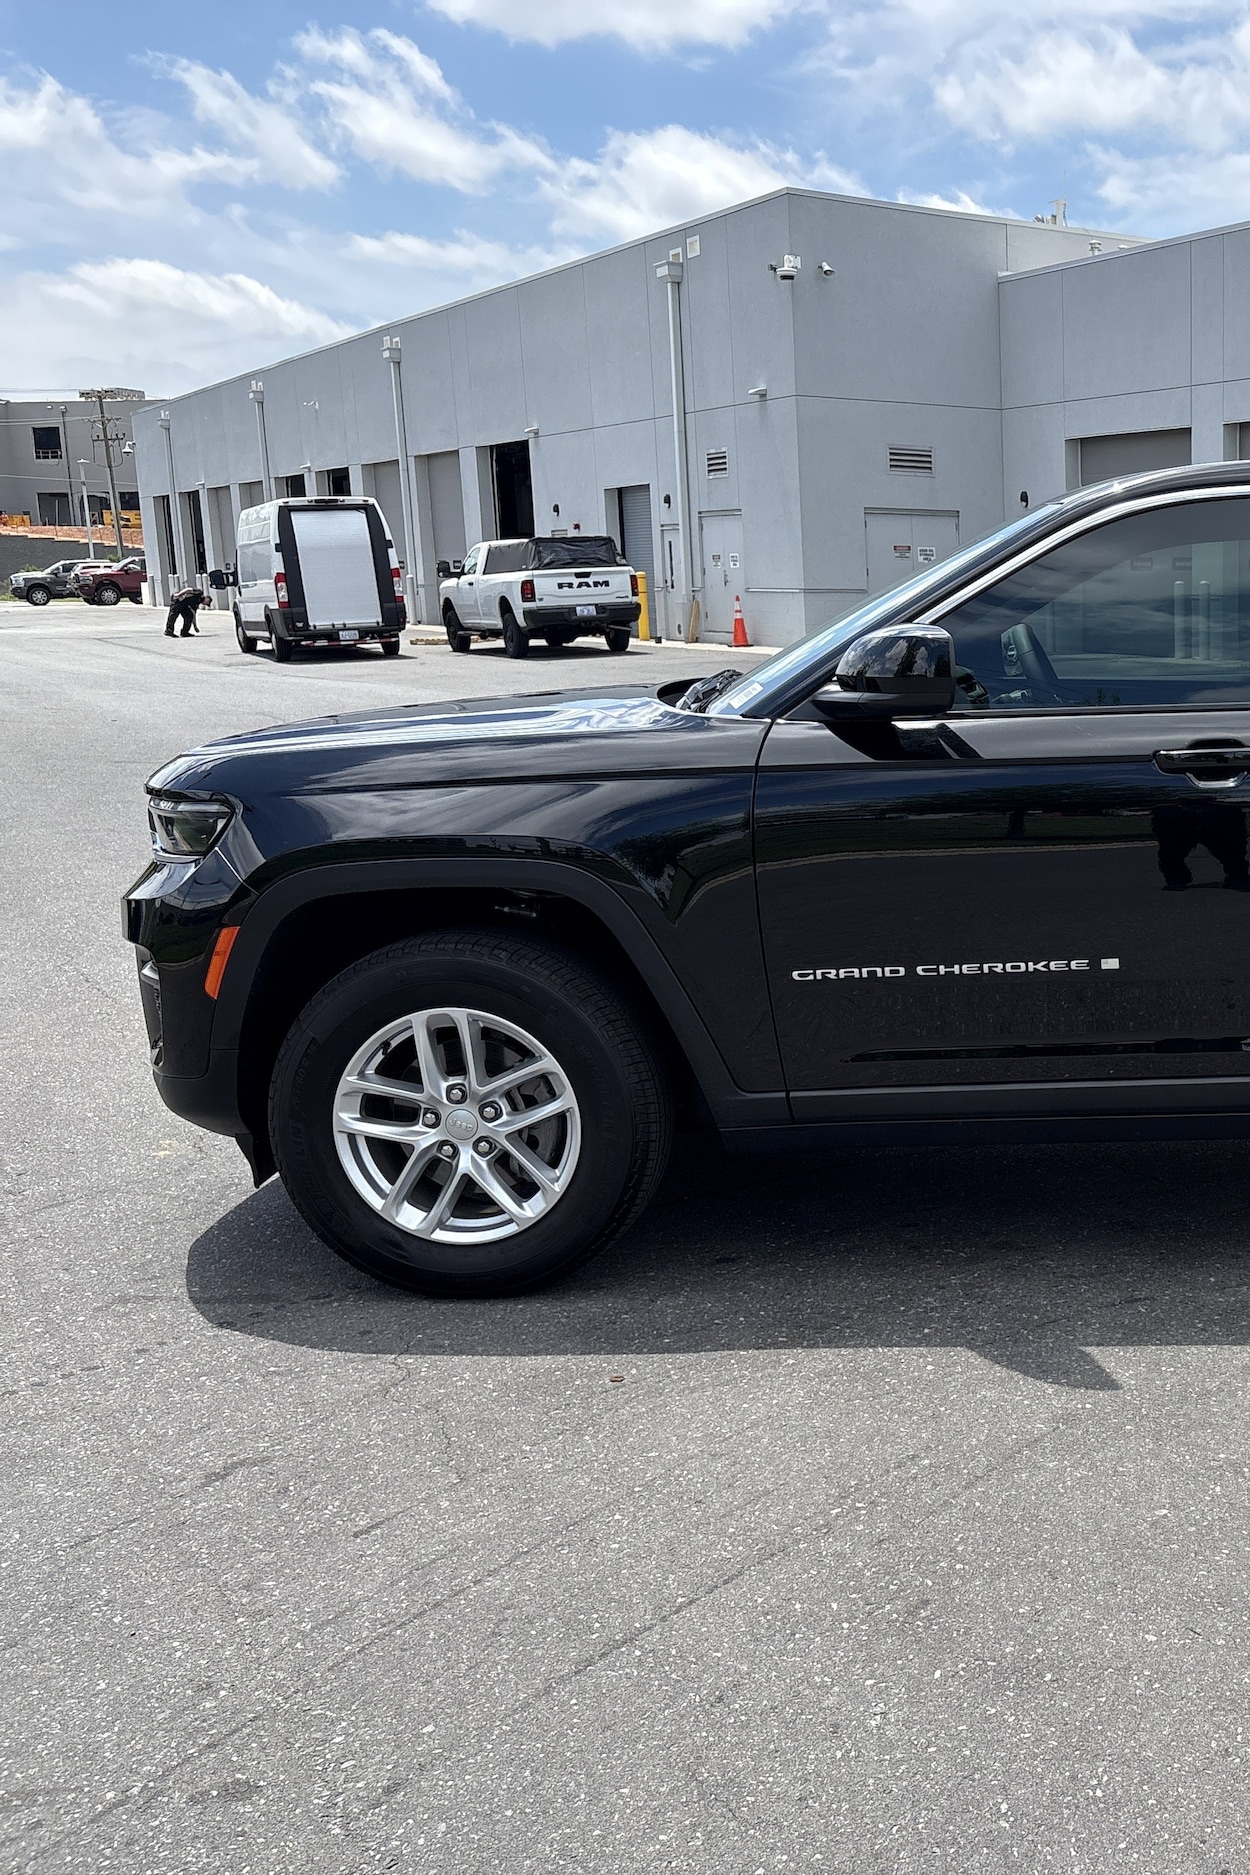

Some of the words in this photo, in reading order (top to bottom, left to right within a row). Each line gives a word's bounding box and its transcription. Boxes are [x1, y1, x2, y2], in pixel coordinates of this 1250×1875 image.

[557, 580, 610, 590] RAM
[791, 966, 906, 981] GRAND
[915, 959, 1091, 976] CHEROKEE
